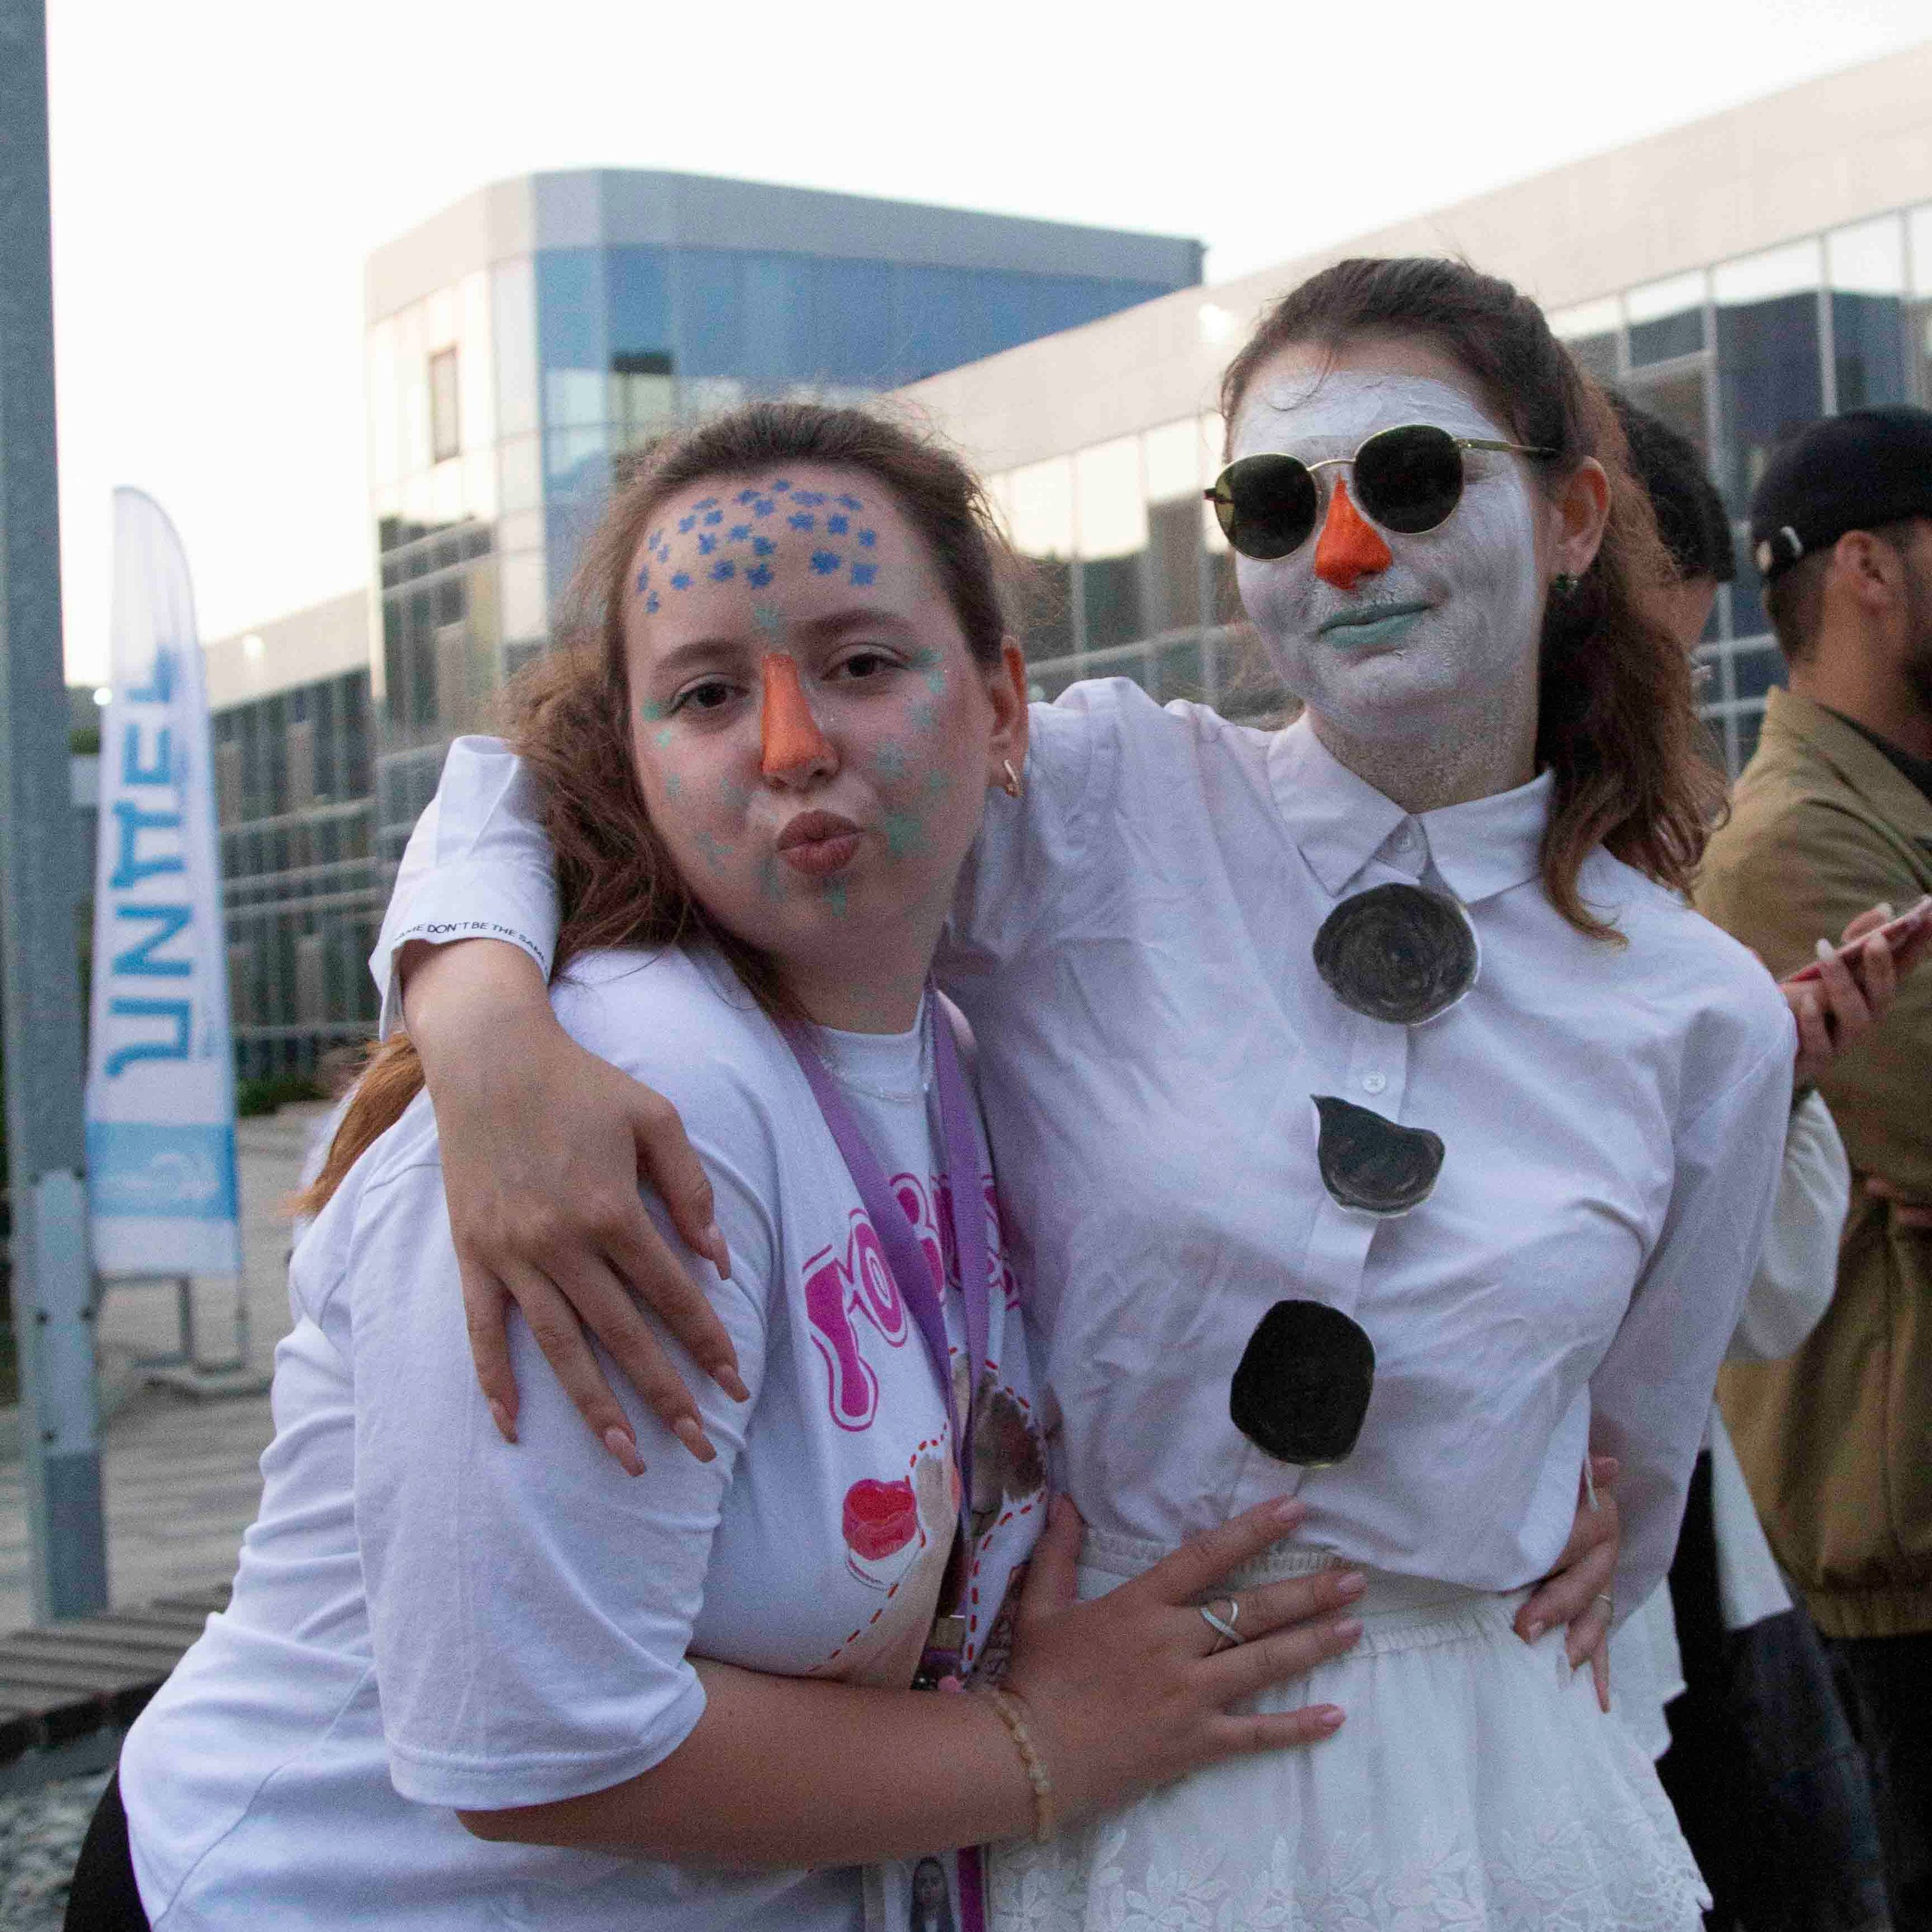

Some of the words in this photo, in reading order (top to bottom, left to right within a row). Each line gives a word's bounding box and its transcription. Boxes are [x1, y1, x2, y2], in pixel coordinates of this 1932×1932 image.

[427, 921, 469, 934] DON'T
[471, 921, 488, 930] BE
[492, 923, 516, 937] THE
